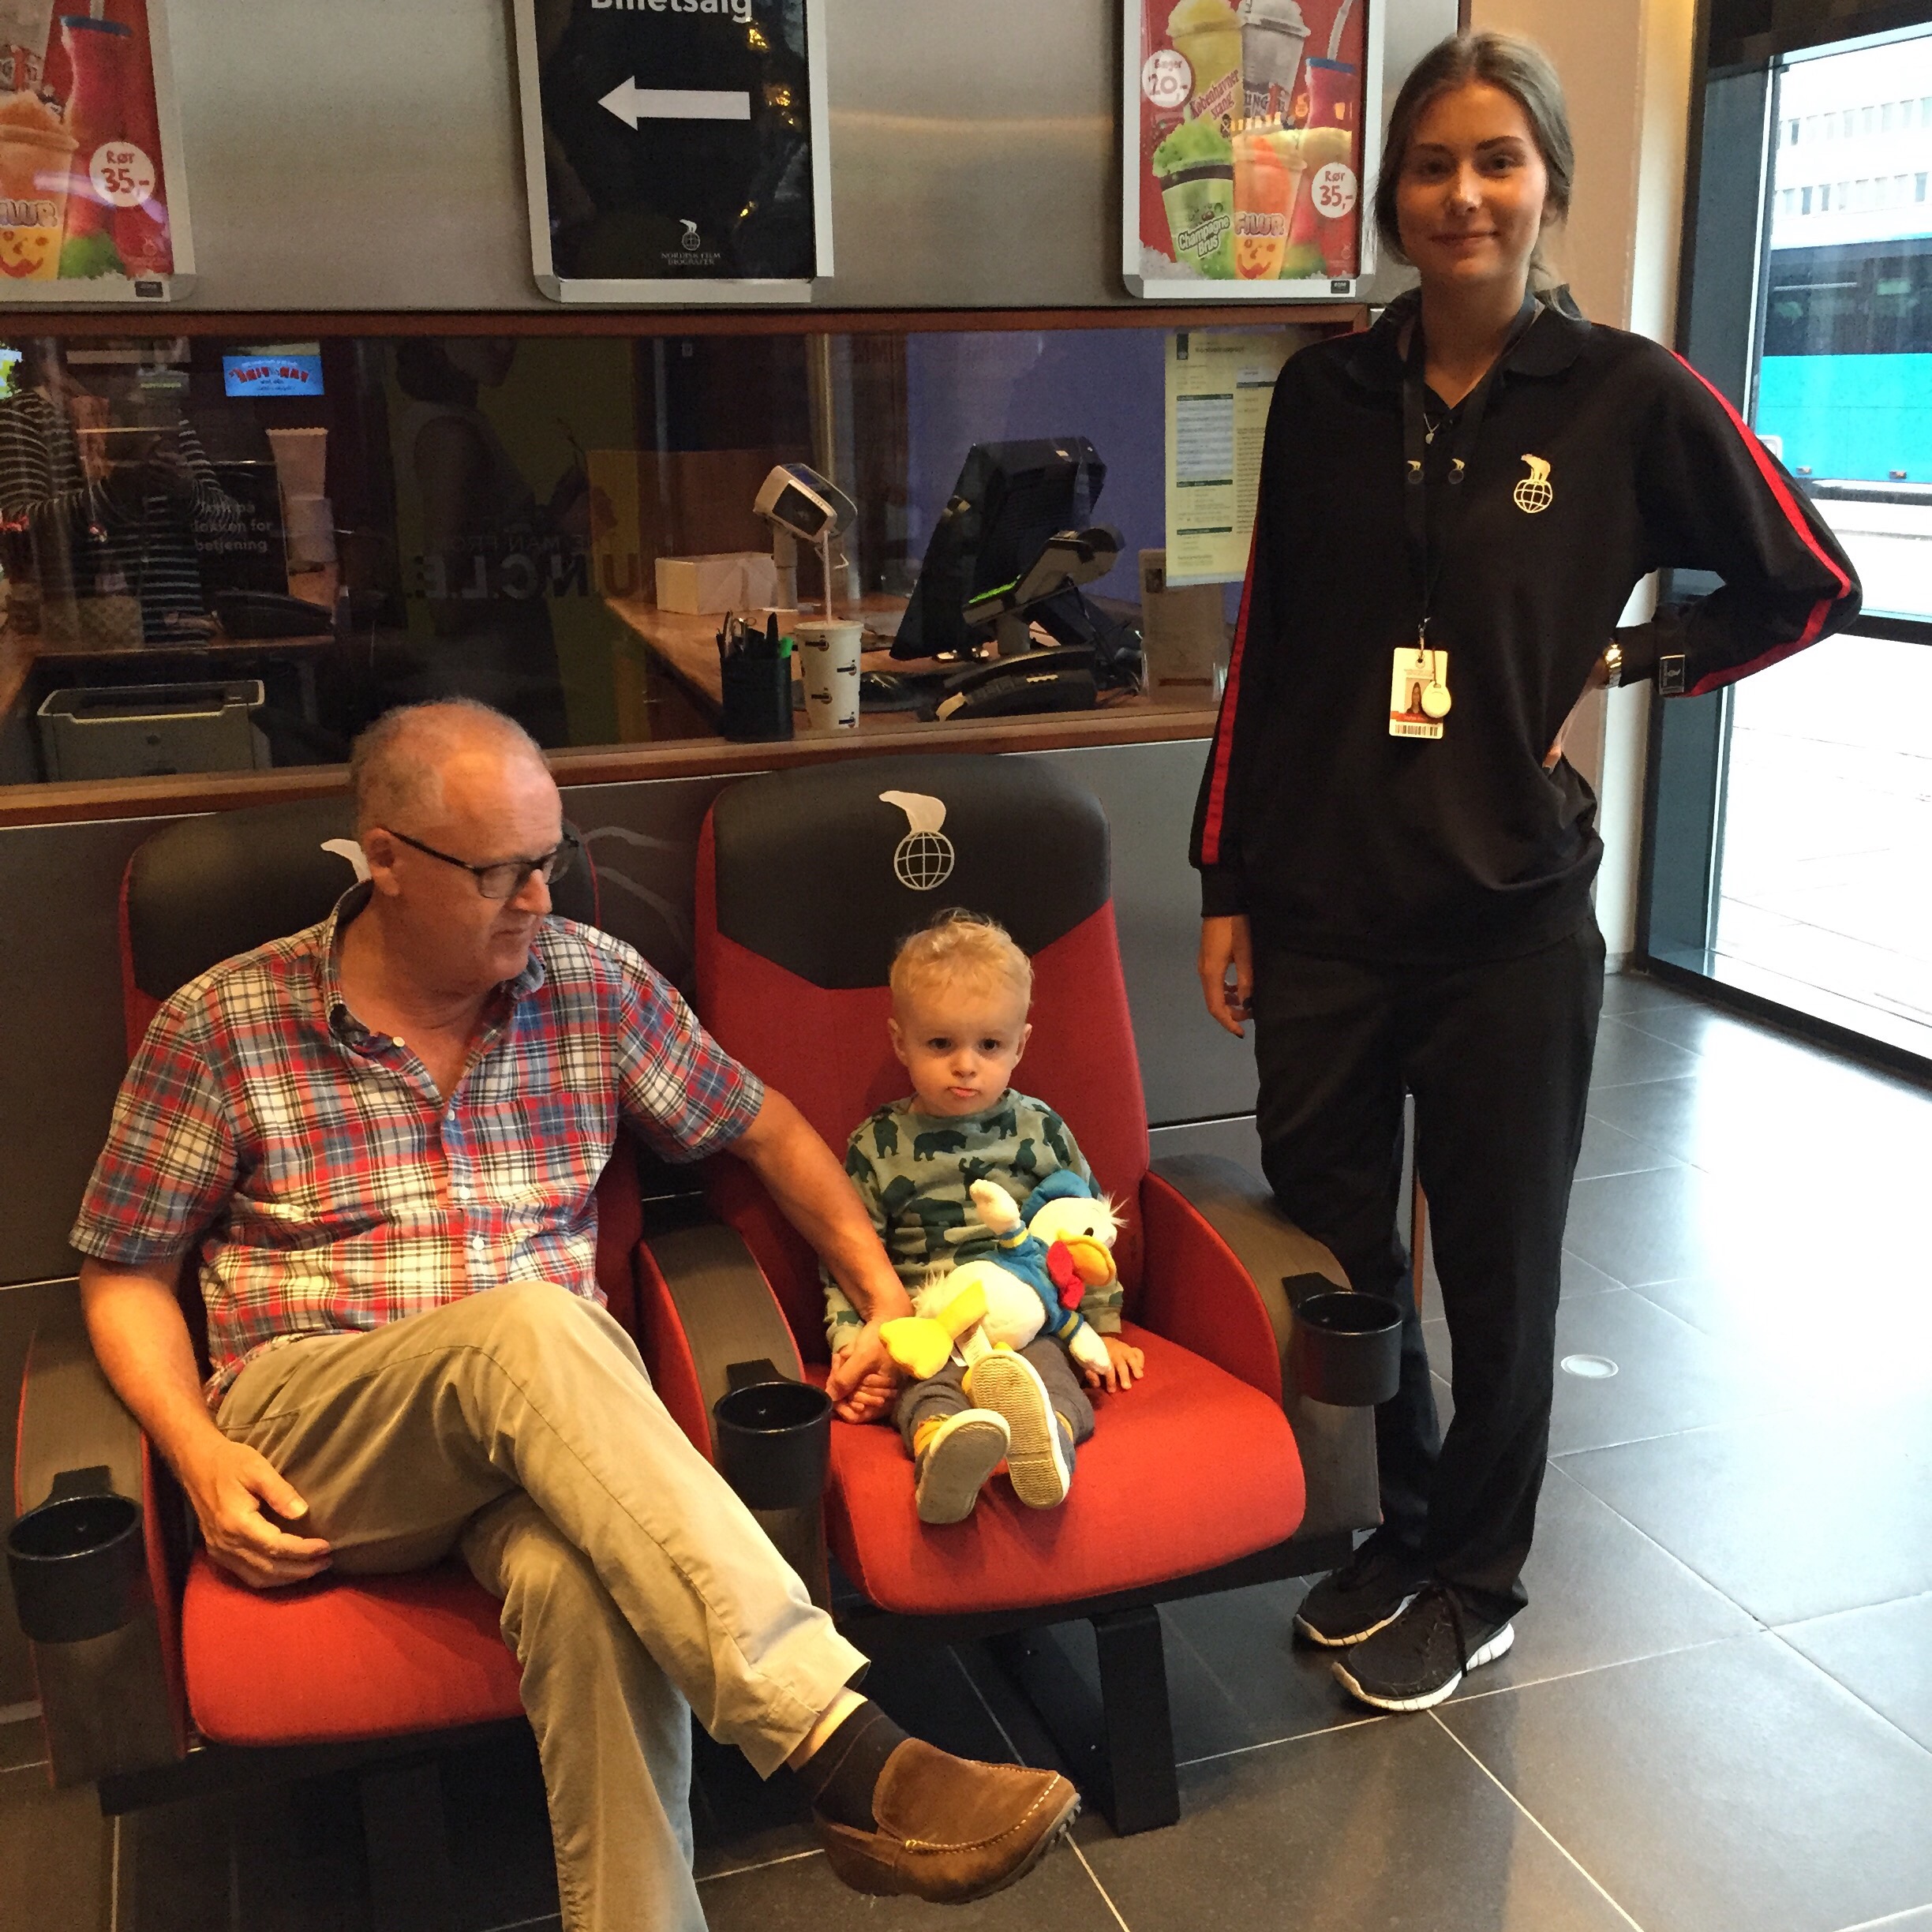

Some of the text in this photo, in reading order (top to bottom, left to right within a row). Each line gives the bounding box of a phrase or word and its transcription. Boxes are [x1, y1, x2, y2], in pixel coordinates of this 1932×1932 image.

[1325, 170, 1345, 182] Rør
[1320, 185, 1353, 209] 35,-
[1178, 216, 1230, 249] Champagne
[1198, 234, 1219, 257] Brus
